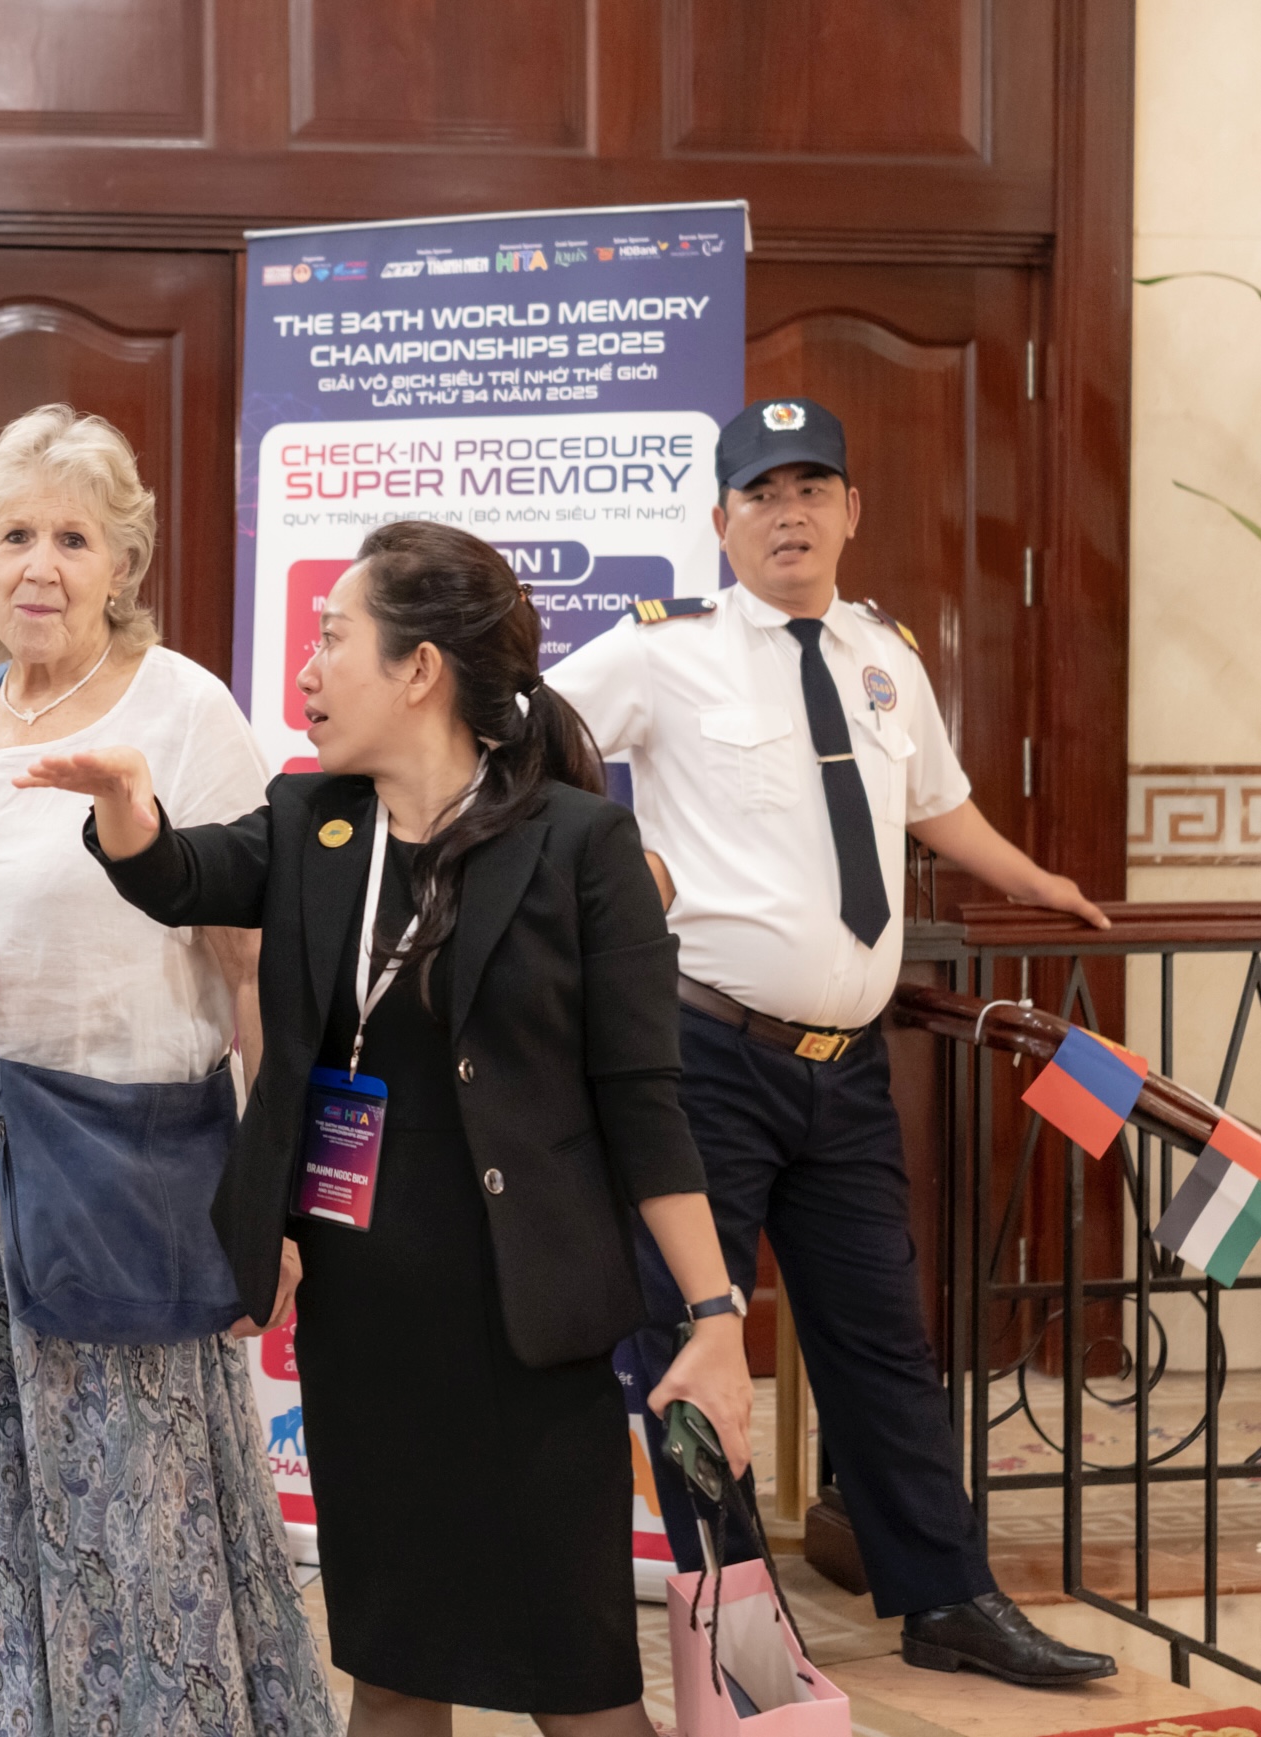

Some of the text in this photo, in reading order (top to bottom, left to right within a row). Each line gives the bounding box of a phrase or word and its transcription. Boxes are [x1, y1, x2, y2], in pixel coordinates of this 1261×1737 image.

[619, 245, 658, 257] HDBank
[273, 296, 710, 338] THE 34TH WORLD MEMORY
[310, 331, 665, 368] CHAMPIONSHIPS 2025
[318, 361, 658, 393] GIẢI VÔ ĐỊCH SIÊU TRÍ NHỚ THẾ GIỚI
[462, 389, 488, 404] 34
[493, 385, 541, 403] NĂM
[545, 385, 599, 402] 2025
[281, 435, 693, 467] CHECK-IN PROCEDURE
[286, 463, 693, 500] SUPER MEMORY
[283, 512, 320, 528] QUY
[326, 509, 378, 526] TRÌNH
[469, 505, 501, 526] (BỘ
[506, 506, 551, 522] MÔN
[556, 505, 596, 522] SIÊU
[601, 504, 631, 520] TRÍ
[636, 504, 686, 524] NHỚ)
[551, 548, 561, 573] 1
[527, 594, 640, 612] FICATION
[539, 641, 572, 654] etter
[306, 1162, 334, 1178] BRAHMI
